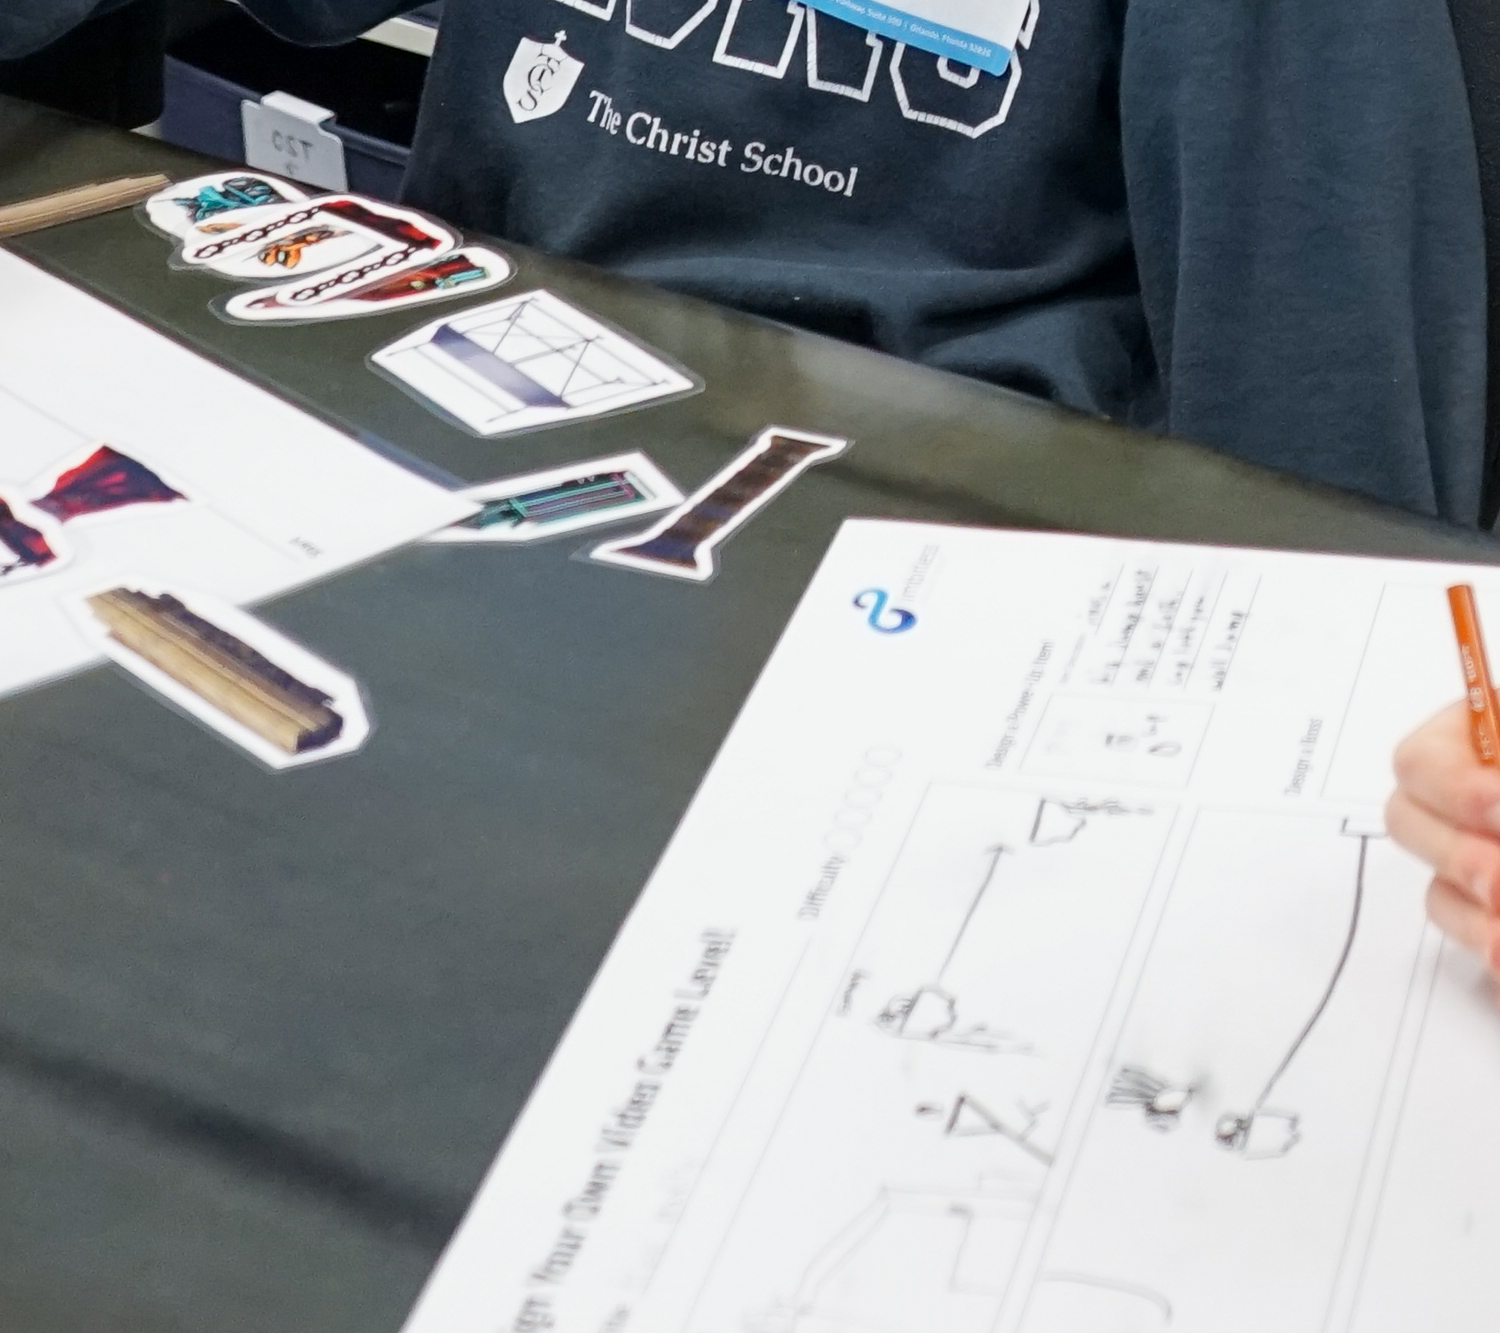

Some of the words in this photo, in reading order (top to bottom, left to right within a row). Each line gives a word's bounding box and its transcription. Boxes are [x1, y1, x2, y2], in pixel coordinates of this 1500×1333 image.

[586, 89, 622, 137] The
[625, 110, 732, 168] Christ
[740, 142, 860, 199] School
[527, 1226, 588, 1286] Your
[562, 1160, 621, 1221] Own
[593, 1080, 663, 1152] Video
[635, 1005, 700, 1076] Game
